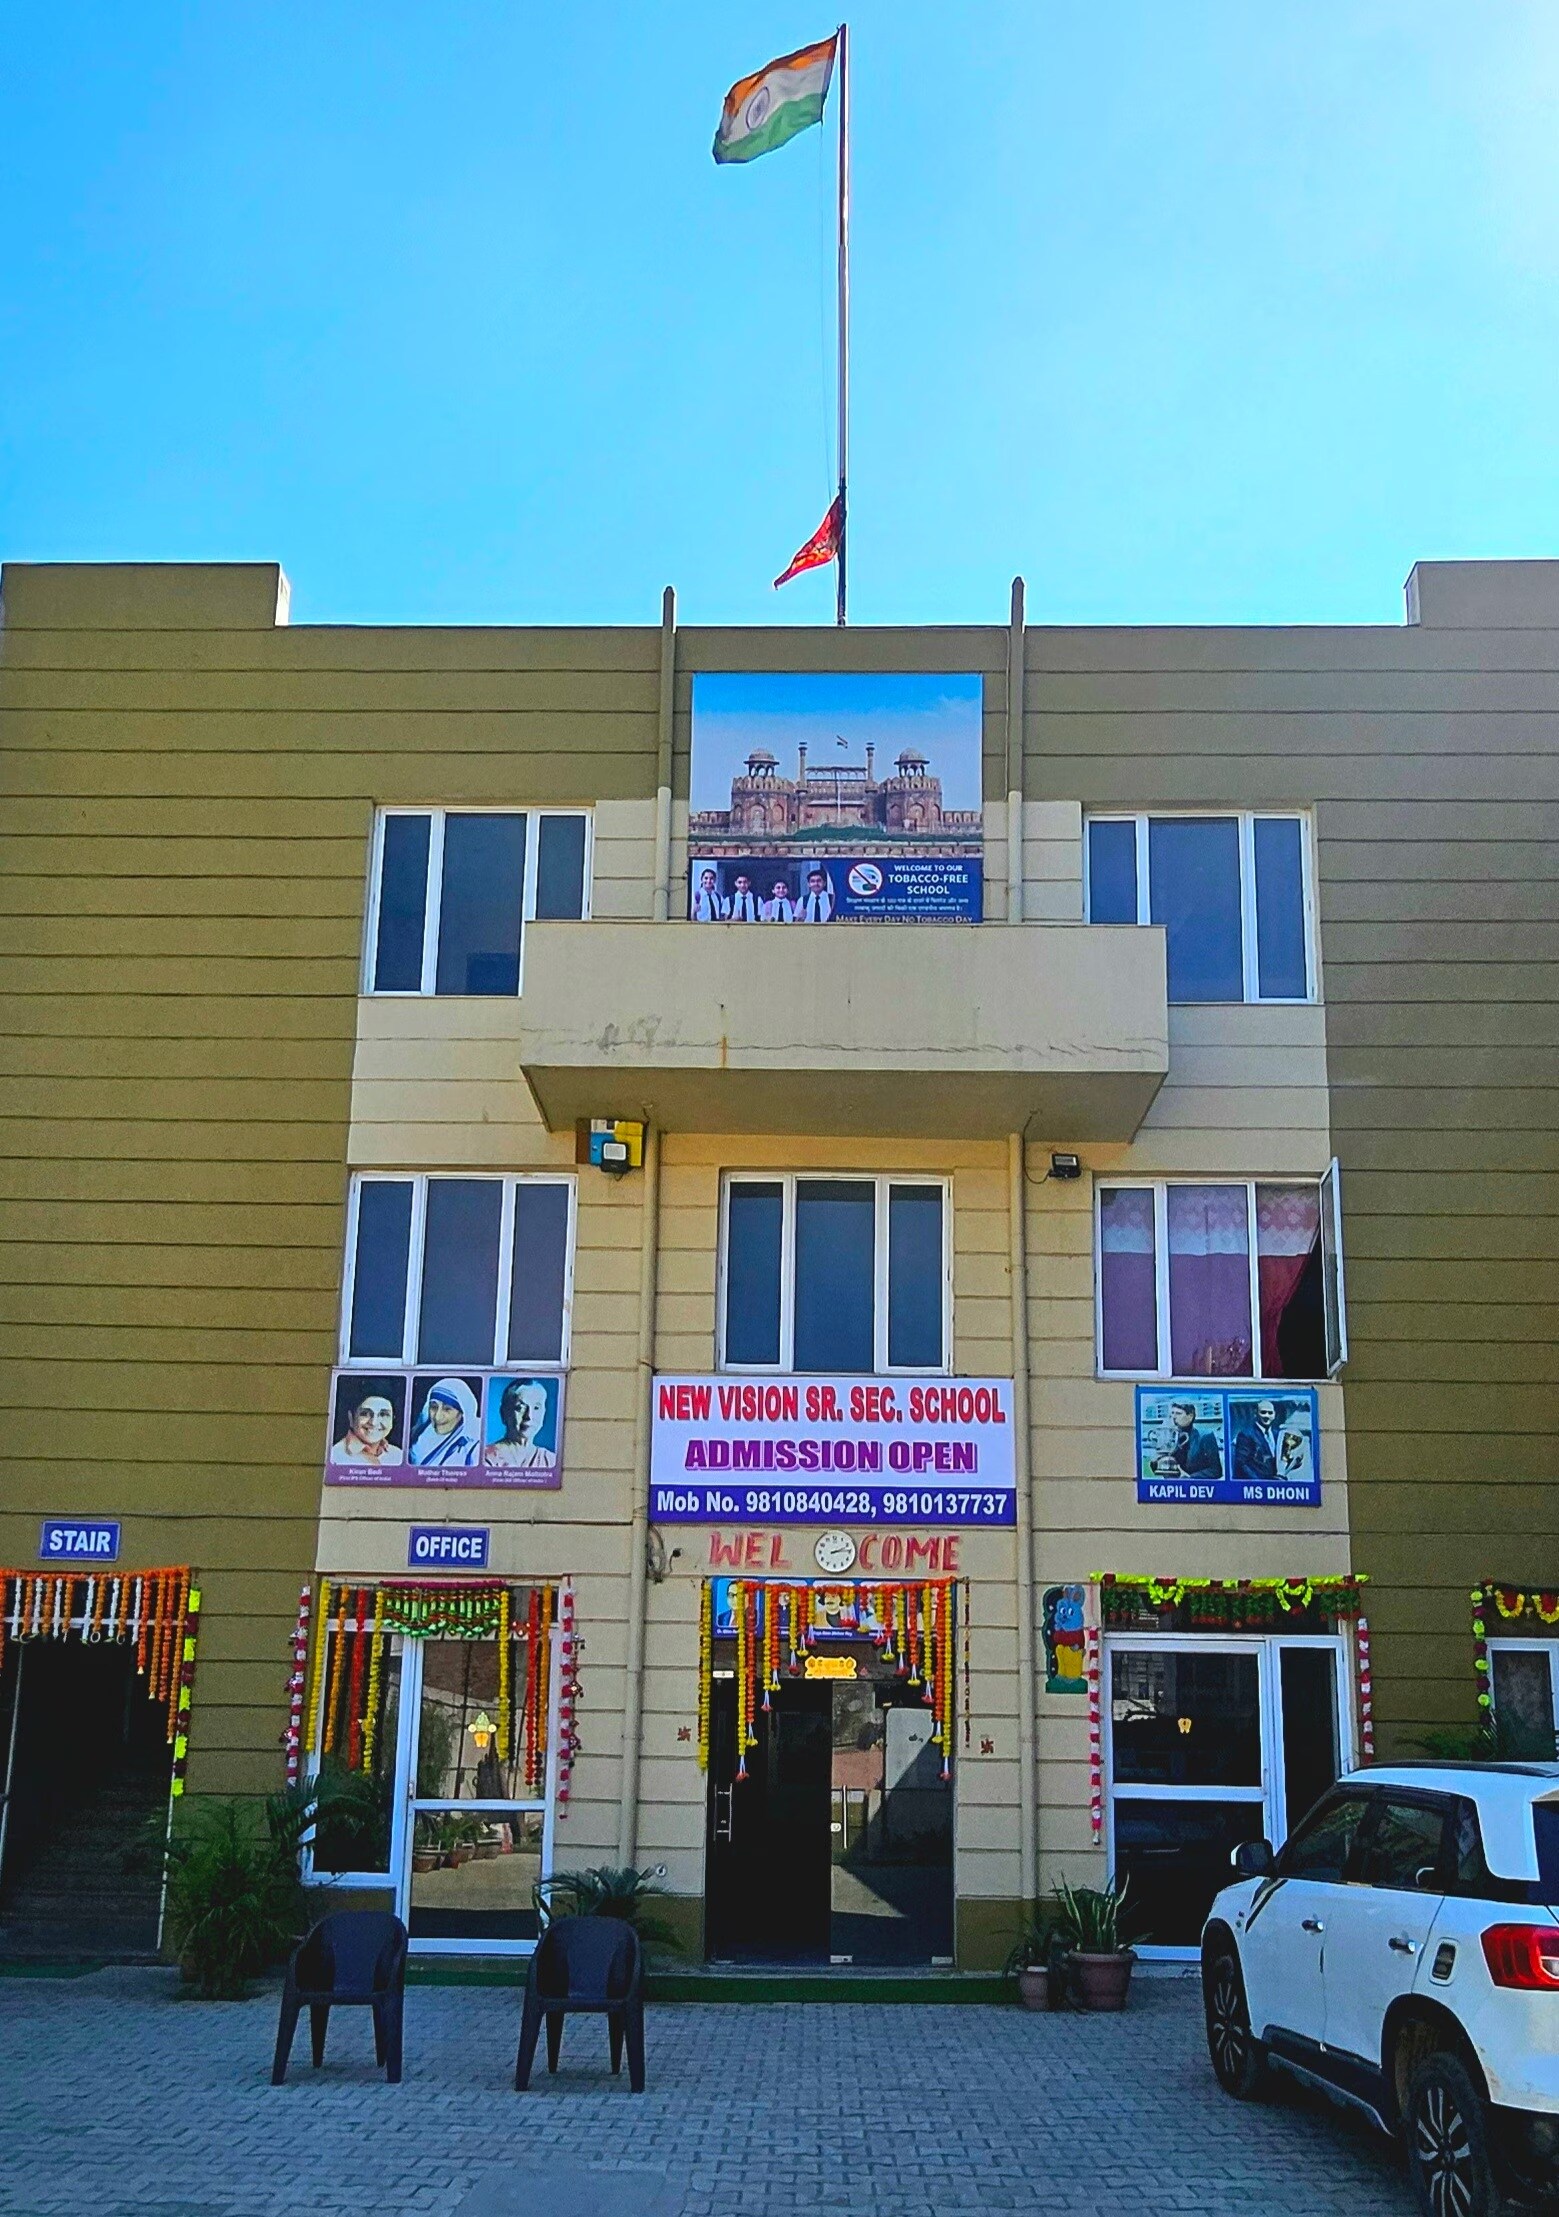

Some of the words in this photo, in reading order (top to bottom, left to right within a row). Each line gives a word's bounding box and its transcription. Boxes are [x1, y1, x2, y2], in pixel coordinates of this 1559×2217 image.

[888, 874, 969, 883] TOBACCO-FREE
[894, 864, 932, 872] WELCOME
[934, 864, 944, 872] TO
[946, 864, 963, 872] OUR
[906, 885, 950, 894] SCHOOL
[659, 1385, 711, 1420] NEW
[718, 1386, 798, 1421] VISION
[805, 1387, 843, 1422] SR.
[850, 1387, 902, 1422] SEC.
[910, 1387, 1006, 1424] SCHOOL
[685, 1440, 882, 1472] ADMISSION
[889, 1441, 978, 1473] OPEN
[1149, 1485, 1186, 1498] KAPIL
[1189, 1486, 1215, 1499] DEV
[1243, 1486, 1263, 1499] MS
[1267, 1487, 1309, 1500] DHONI
[657, 1490, 699, 1512] Mob
[706, 1491, 739, 1512] No.
[746, 1491, 876, 1518] 9810840428,
[883, 1493, 1007, 1515] 9810137737
[49, 1530, 111, 1552] STAIR
[415, 1536, 482, 1559] OFFICE
[709, 1531, 792, 1568] WEL
[858, 1533, 961, 1571] COME
